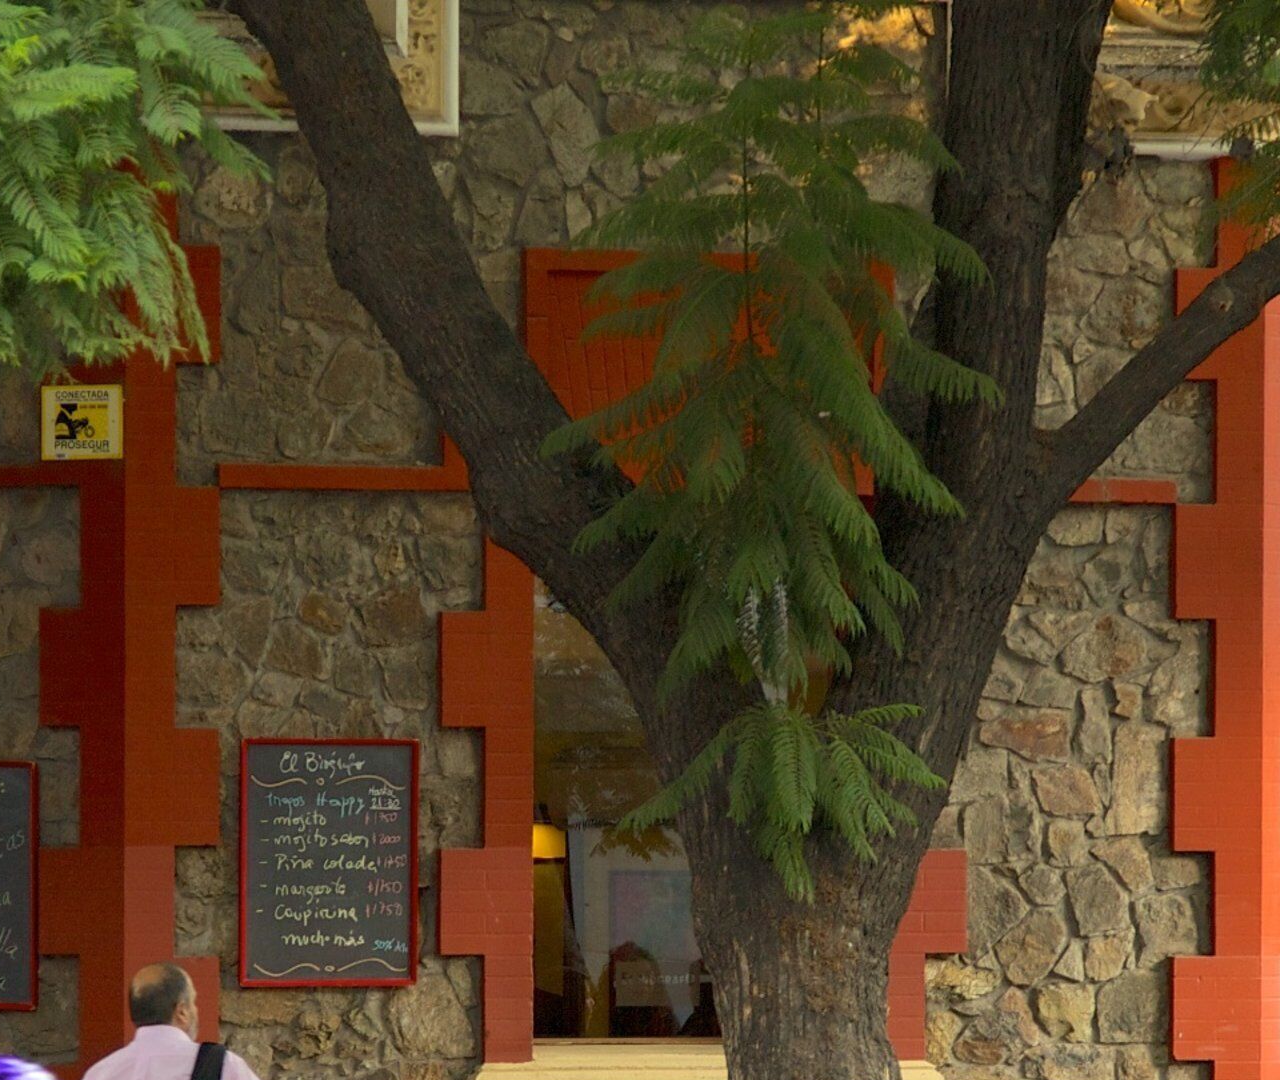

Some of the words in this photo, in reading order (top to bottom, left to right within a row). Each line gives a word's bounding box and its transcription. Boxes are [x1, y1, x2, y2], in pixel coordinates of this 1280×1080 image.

[54, 390, 110, 399] CONECTADA
[54, 440, 110, 450] PROSEGUR
[279, 751, 298, 773] El
[317, 792, 365, 818] Happy
